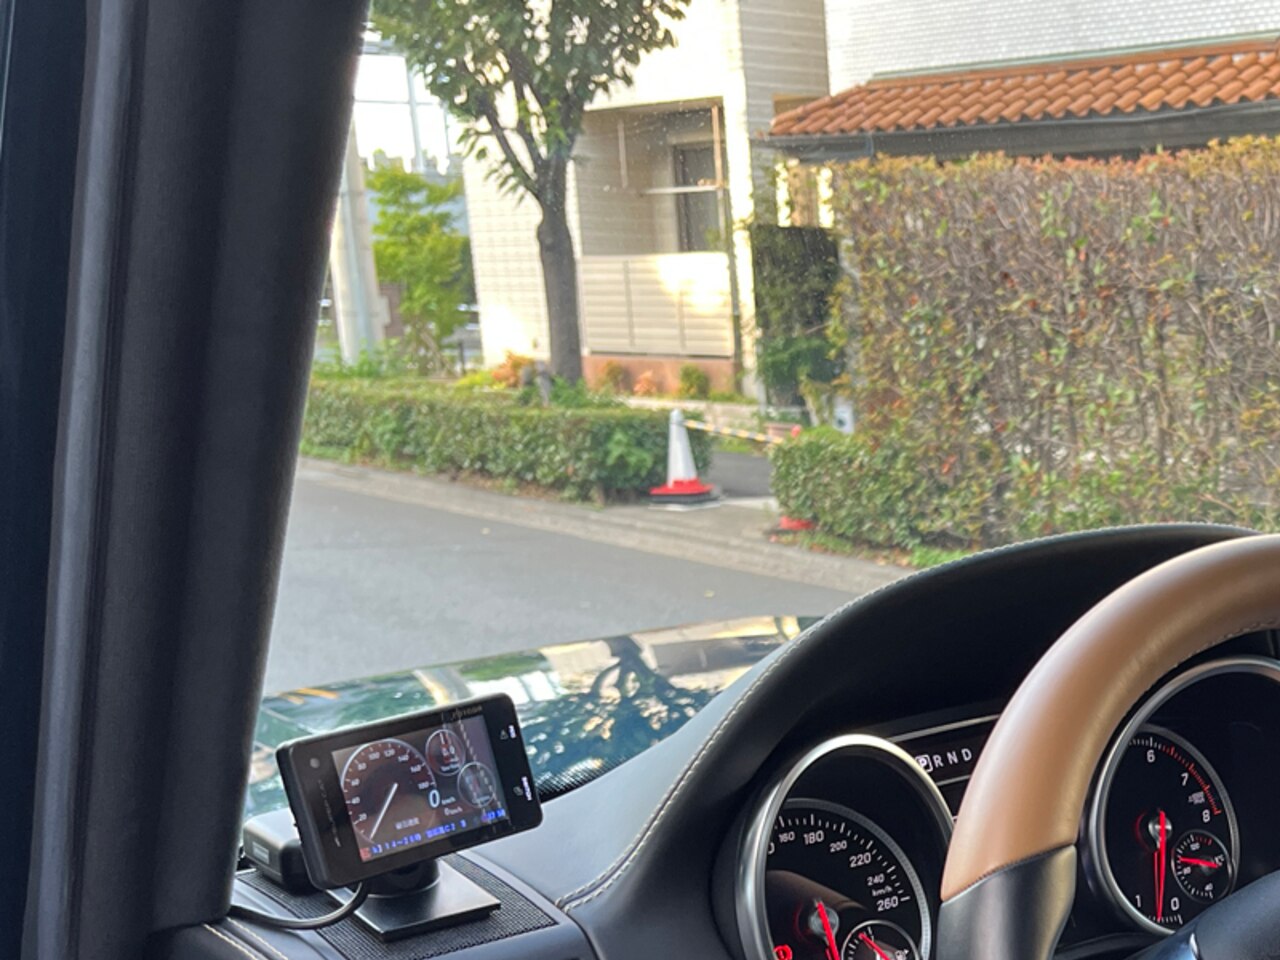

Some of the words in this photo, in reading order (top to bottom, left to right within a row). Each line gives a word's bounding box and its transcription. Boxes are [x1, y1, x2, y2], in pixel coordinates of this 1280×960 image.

[932, 754, 944, 768] R
[946, 750, 958, 765] N
[961, 748, 972, 762] D
[1146, 749, 1156, 763] 6
[1180, 772, 1190, 787] 7
[428, 788, 441, 809] 0
[1202, 809, 1211, 823] 8
[778, 831, 796, 844] 160
[803, 829, 825, 846] 180
[829, 840, 848, 854] 200
[849, 851, 872, 869] 220
[866, 873, 886, 887] 240
[871, 884, 893, 898] km/h
[876, 894, 899, 913] 260
[1135, 894, 1142, 908] 1
[1170, 896, 1180, 911] 0
